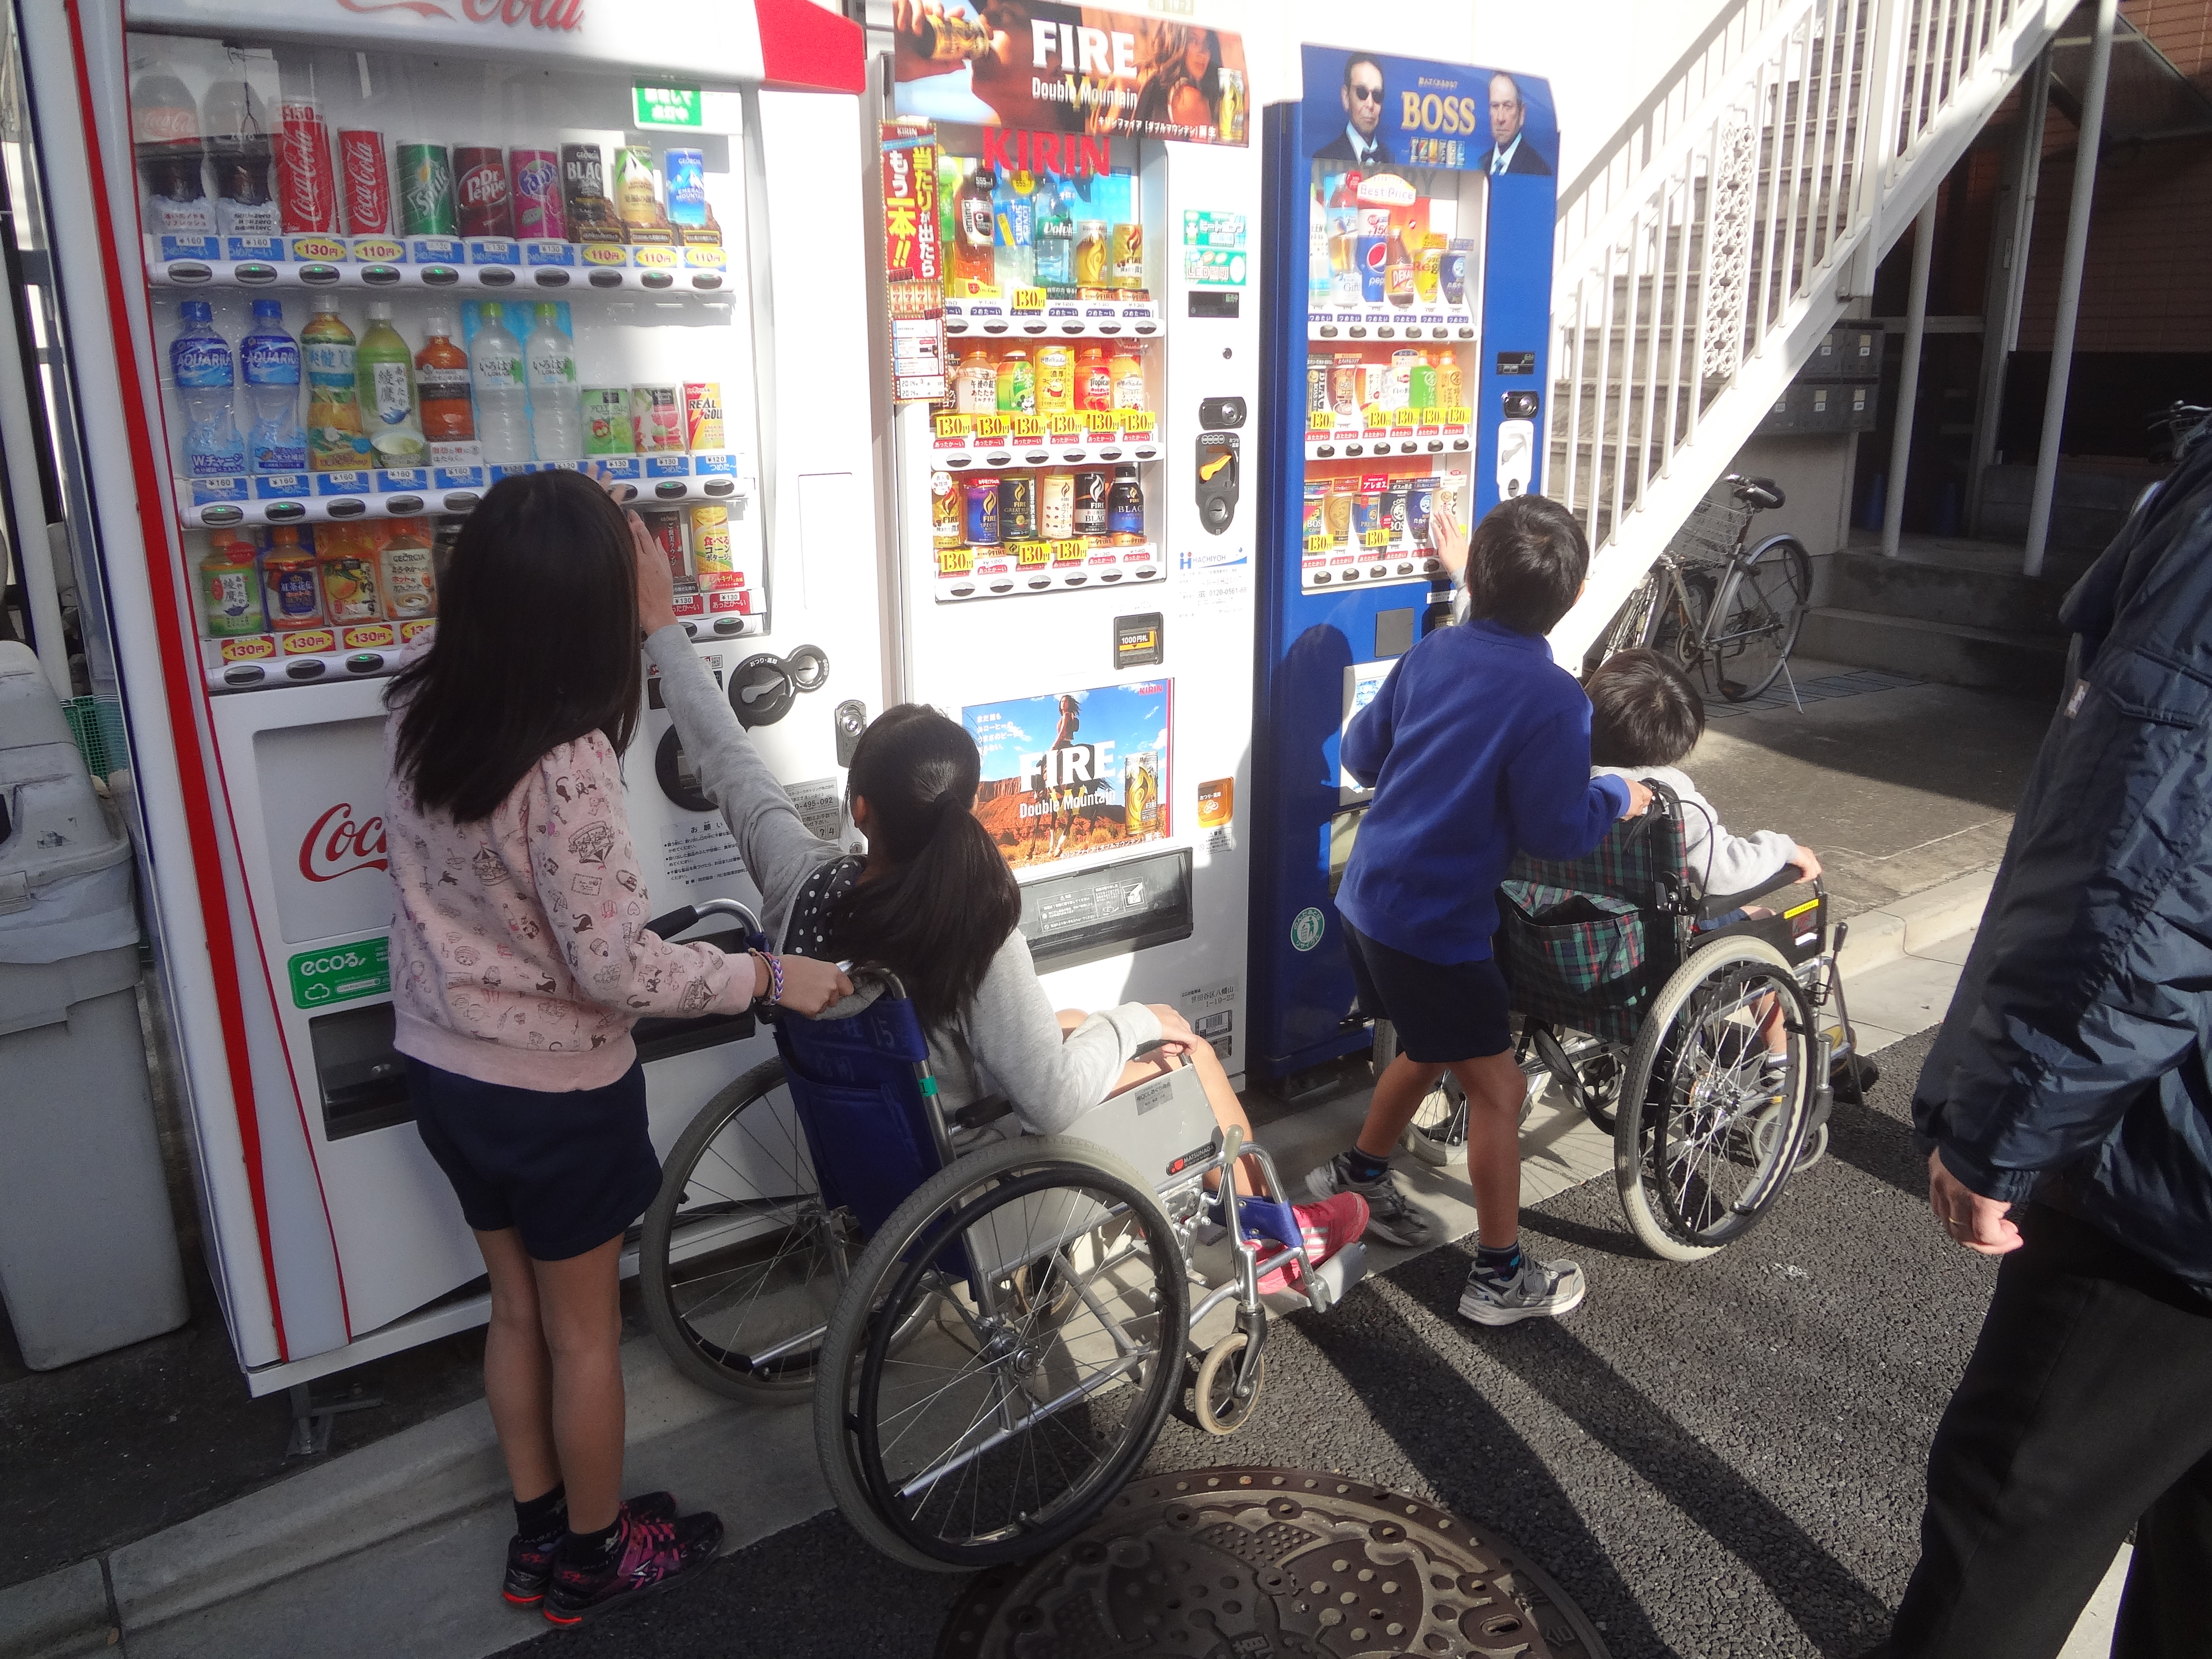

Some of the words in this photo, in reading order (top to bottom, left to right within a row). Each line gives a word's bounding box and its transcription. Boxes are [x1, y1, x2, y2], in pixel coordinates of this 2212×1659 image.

[1031, 19, 1138, 78] FIRE
[1032, 76, 1077, 101] Double
[1080, 84, 1138, 110] Mountain
[1401, 91, 1476, 136] BOSS
[897, 127, 918, 136] KIRIN
[982, 127, 1111, 178] KIRIN
[1359, 183, 1385, 195] Best
[1388, 187, 1414, 200] Price
[913, 146, 935, 277] 当たりが出たら
[303, 244, 338, 257] 130円
[362, 245, 394, 258] 110円
[591, 249, 619, 260] 110円
[644, 252, 671, 263] 110円
[694, 252, 721, 262] 110円
[1344, 282, 1360, 292] Gift
[1015, 290, 1045, 308] 130円
[689, 398, 717, 409] REAL
[1091, 414, 1119, 431] 130円
[1127, 413, 1154, 430] 130円
[1312, 413, 1335, 428] 130円
[1370, 412, 1392, 426] 130円
[1397, 410, 1419, 425] 130円
[1424, 409, 1445, 424] 130円
[1449, 408, 1470, 422] 130円
[938, 418, 970, 435] 130円
[979, 418, 1010, 435] 130円
[1016, 417, 1046, 434] 130円
[1053, 416, 1082, 433] 130円
[934, 439, 965, 448] あったか〜い
[974, 438, 1004, 446] あったか〜い
[1087, 434, 1115, 443] あったか〜い
[704, 536, 730, 546] 食べる
[1309, 535, 1333, 552] 130円
[1367, 530, 1389, 547] 130円
[705, 545, 731, 555] コーン
[706, 553, 732, 562] ポタージュ
[1020, 546, 1050, 563] 130円
[1058, 541, 1087, 559] 130円
[942, 553, 974, 571] 130円
[1192, 554, 1226, 563] HACHIYOH
[290, 636, 324, 648] 130円
[353, 632, 385, 644] 130円
[1121, 634, 1148, 645] 1000円札
[230, 644, 265, 657] 130円
[1139, 685, 1163, 697] KIRIN
[1019, 740, 1116, 793] FIRE
[1019, 796, 1060, 819] Double
[1063, 788, 1116, 811] Mountain
[690, 822, 723, 834] お願い
[829, 827, 835, 835] 4
[1191, 986, 1234, 1004] 世田谷区八幡山
[1183, 1144, 1214, 1164] MATSUNAGA
